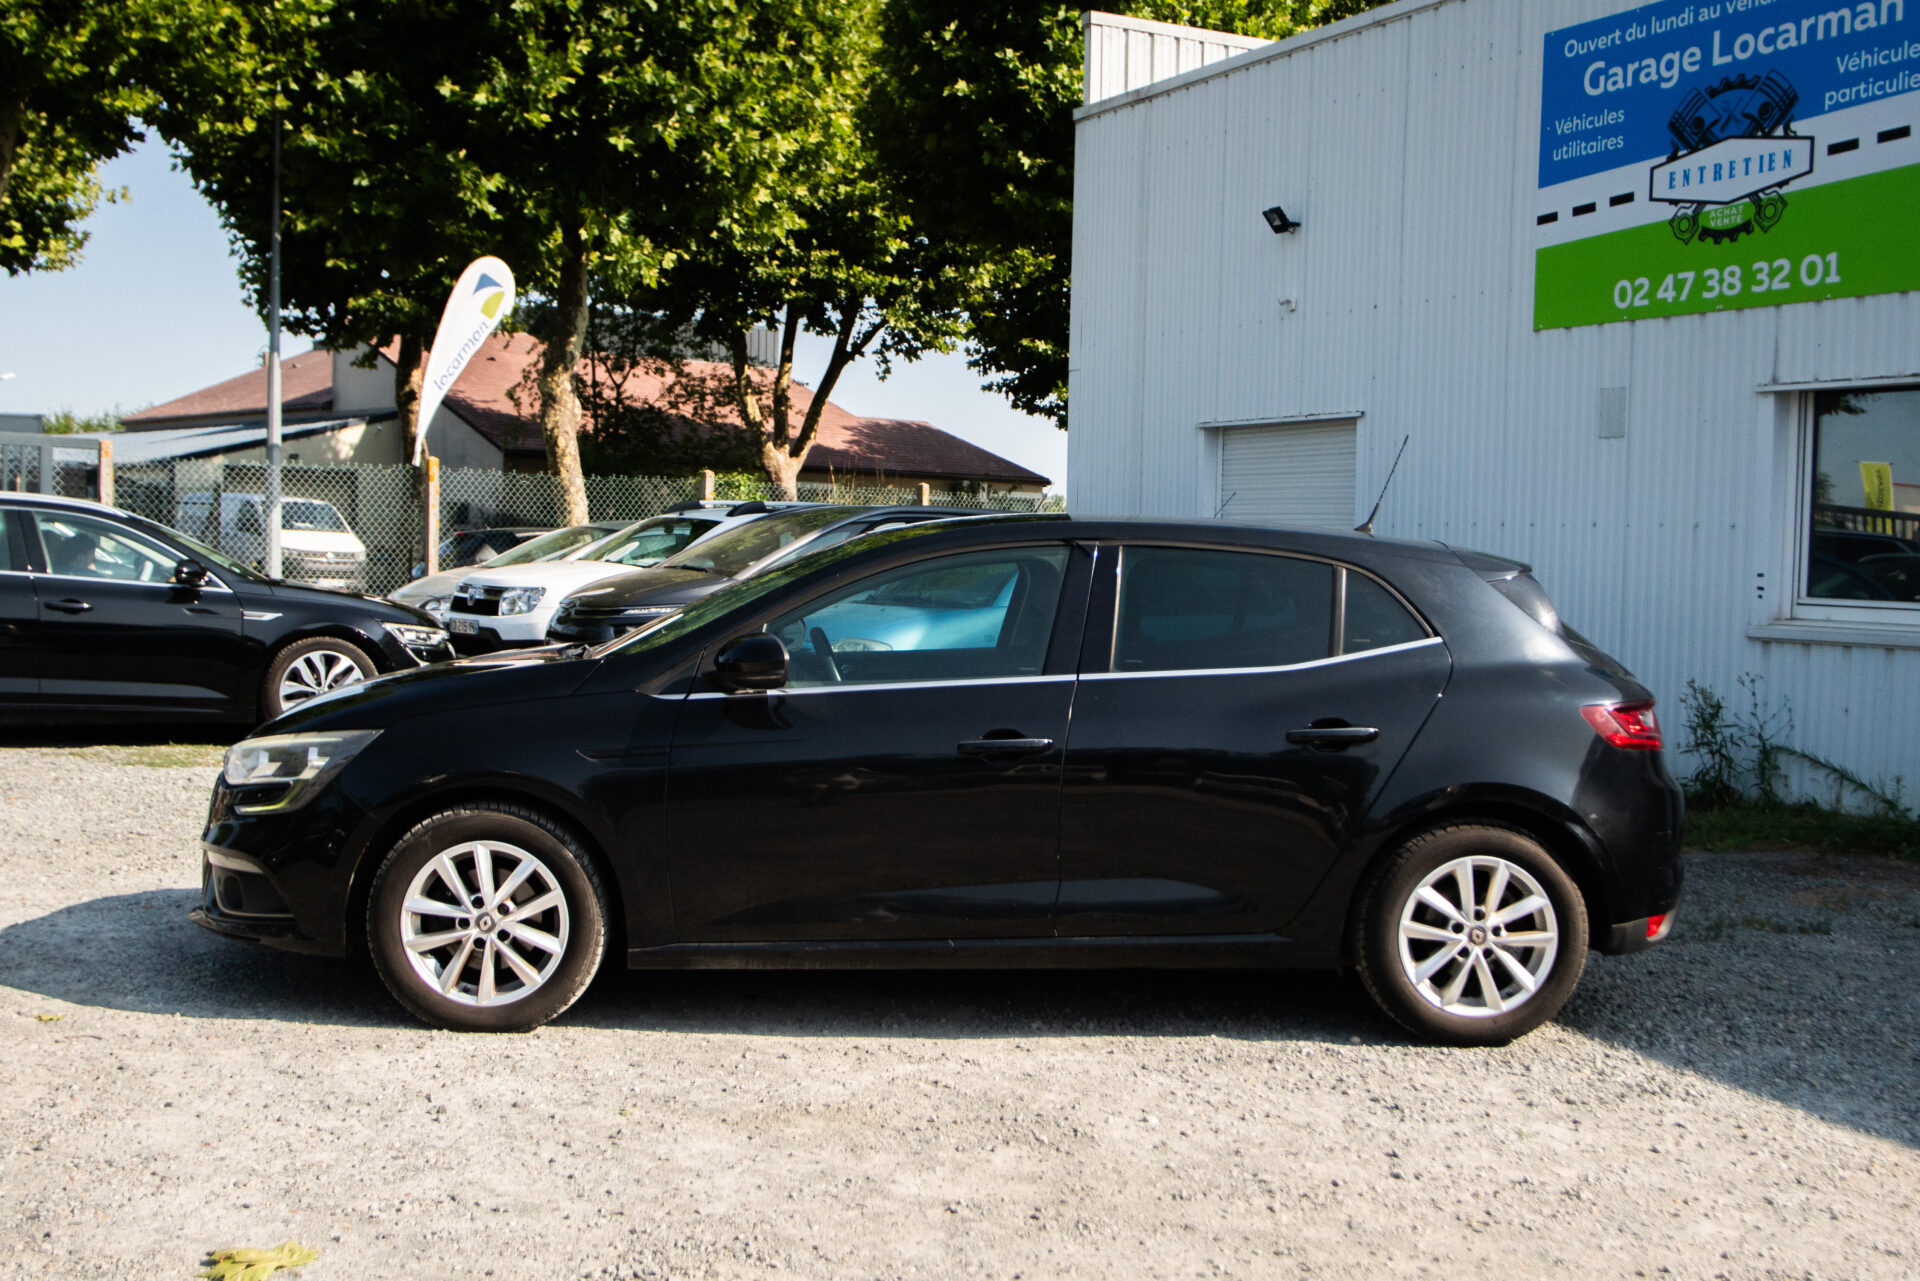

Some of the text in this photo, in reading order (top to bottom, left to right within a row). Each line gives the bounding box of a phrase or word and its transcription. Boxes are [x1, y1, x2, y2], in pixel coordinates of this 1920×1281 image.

[1564, 29, 1621, 58] Ouvert
[1625, 23, 1647, 42] du
[1651, 6, 1694, 35] lundi
[1698, 4, 1720, 22] au
[1584, 0, 1904, 96] Garage Locarman
[1555, 109, 1625, 135] Véhicules
[1553, 135, 1624, 161] utilitaires
[1668, 149, 1792, 190] ENTRETIEN
[1710, 205, 1744, 217] ACHAT
[1710, 215, 1743, 227] VENTE
[1613, 252, 1841, 309] 02 47 38 32 01
[433, 321, 489, 391] locarman
